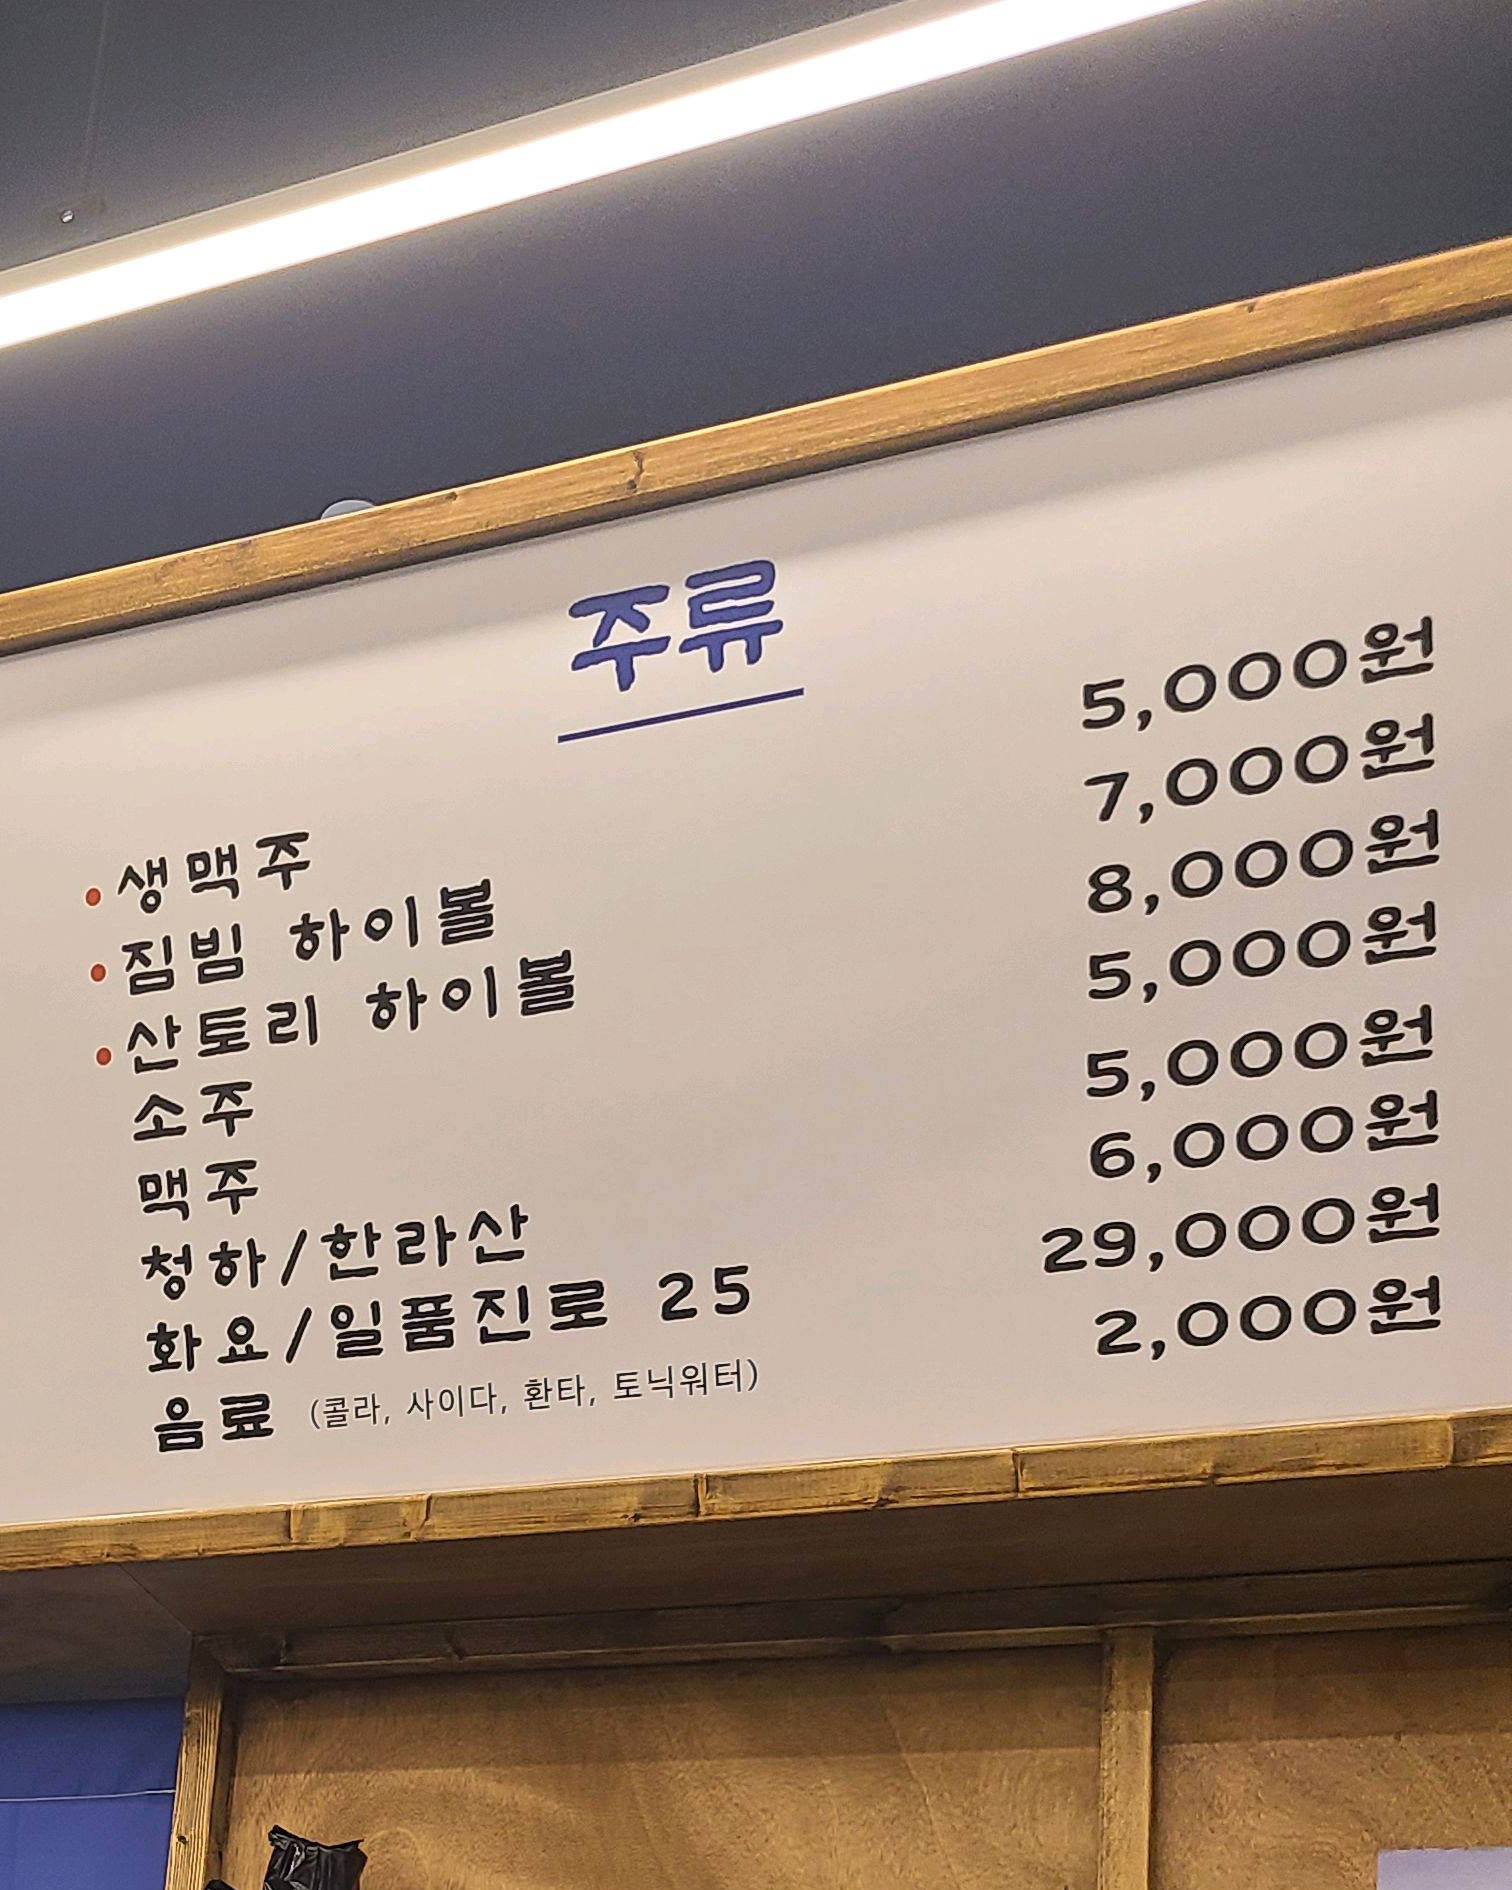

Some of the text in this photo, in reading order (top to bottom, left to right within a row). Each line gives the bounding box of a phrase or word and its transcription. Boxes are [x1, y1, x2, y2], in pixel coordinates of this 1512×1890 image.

[569, 559, 784, 692] 주류
[1082, 616, 1434, 731] 5,000원
[1083, 713, 1435, 824] 7,000원
[117, 832, 311, 914] 생맥주
[1087, 809, 1440, 915] 8,000원
[122, 879, 495, 995] 짐빔 하이볼
[1088, 901, 1437, 1003] 5,000원
[127, 949, 575, 1074] 산토리 하이볼
[1086, 1004, 1433, 1101] 5,000원
[133, 1081, 254, 1141] 소주
[1089, 1090, 1439, 1184] 6,000원
[138, 1159, 259, 1221] 맥주
[1041, 1182, 1440, 1273] 29,000원
[141, 1204, 529, 1300] 청하/한라산
[145, 1266, 751, 1372] 화요/일품진로 25
[1094, 1276, 1441, 1361] 2,000원
[154, 1359, 760, 1453] 음료 (콜라, 사이다, 환타, 토닉워터)
